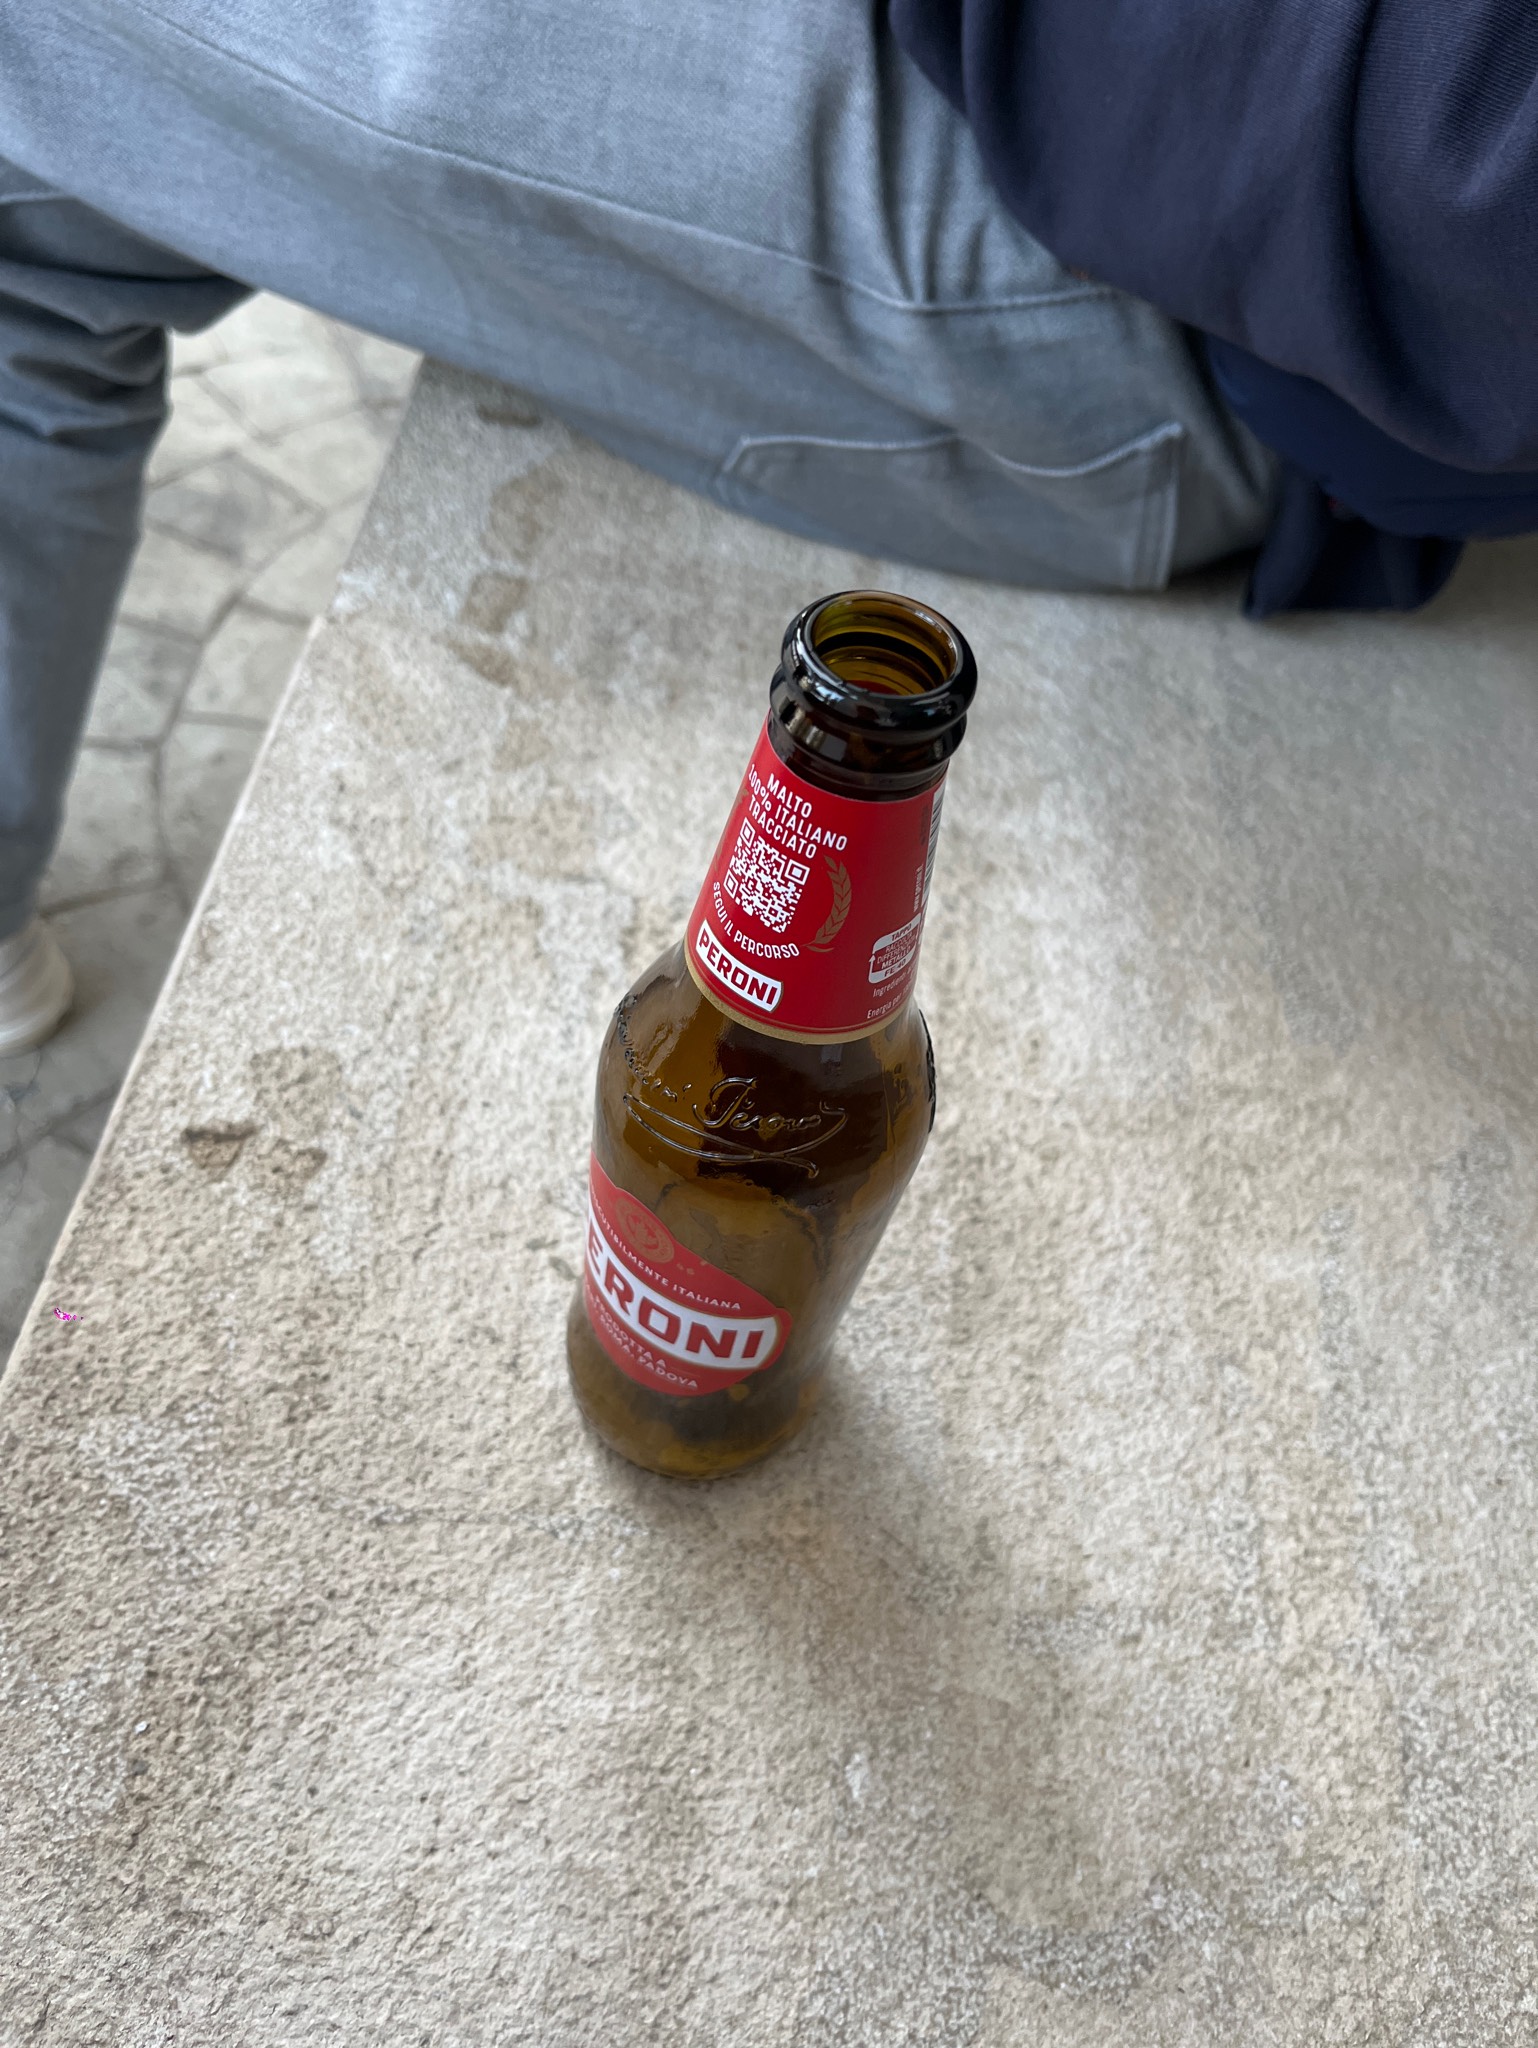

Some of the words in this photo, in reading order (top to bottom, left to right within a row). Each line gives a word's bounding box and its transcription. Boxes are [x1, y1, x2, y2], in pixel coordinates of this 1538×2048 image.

[749, 764, 772, 811] 100%
[775, 805, 847, 851] ITALIANO
[749, 794, 817, 859] TRACCIATO
[767, 773, 812, 818] MALTO
[713, 881, 728, 923] SEGUI
[724, 920, 734, 936] IL
[733, 930, 800, 959] PERCORSO
[698, 928, 778, 1005] PERONI
[588, 1218, 764, 1360] ERONI
[673, 1284, 741, 1310] ITALIANA
[637, 1355, 698, 1388] PADOVA
[656, 1359, 667, 1368] A
